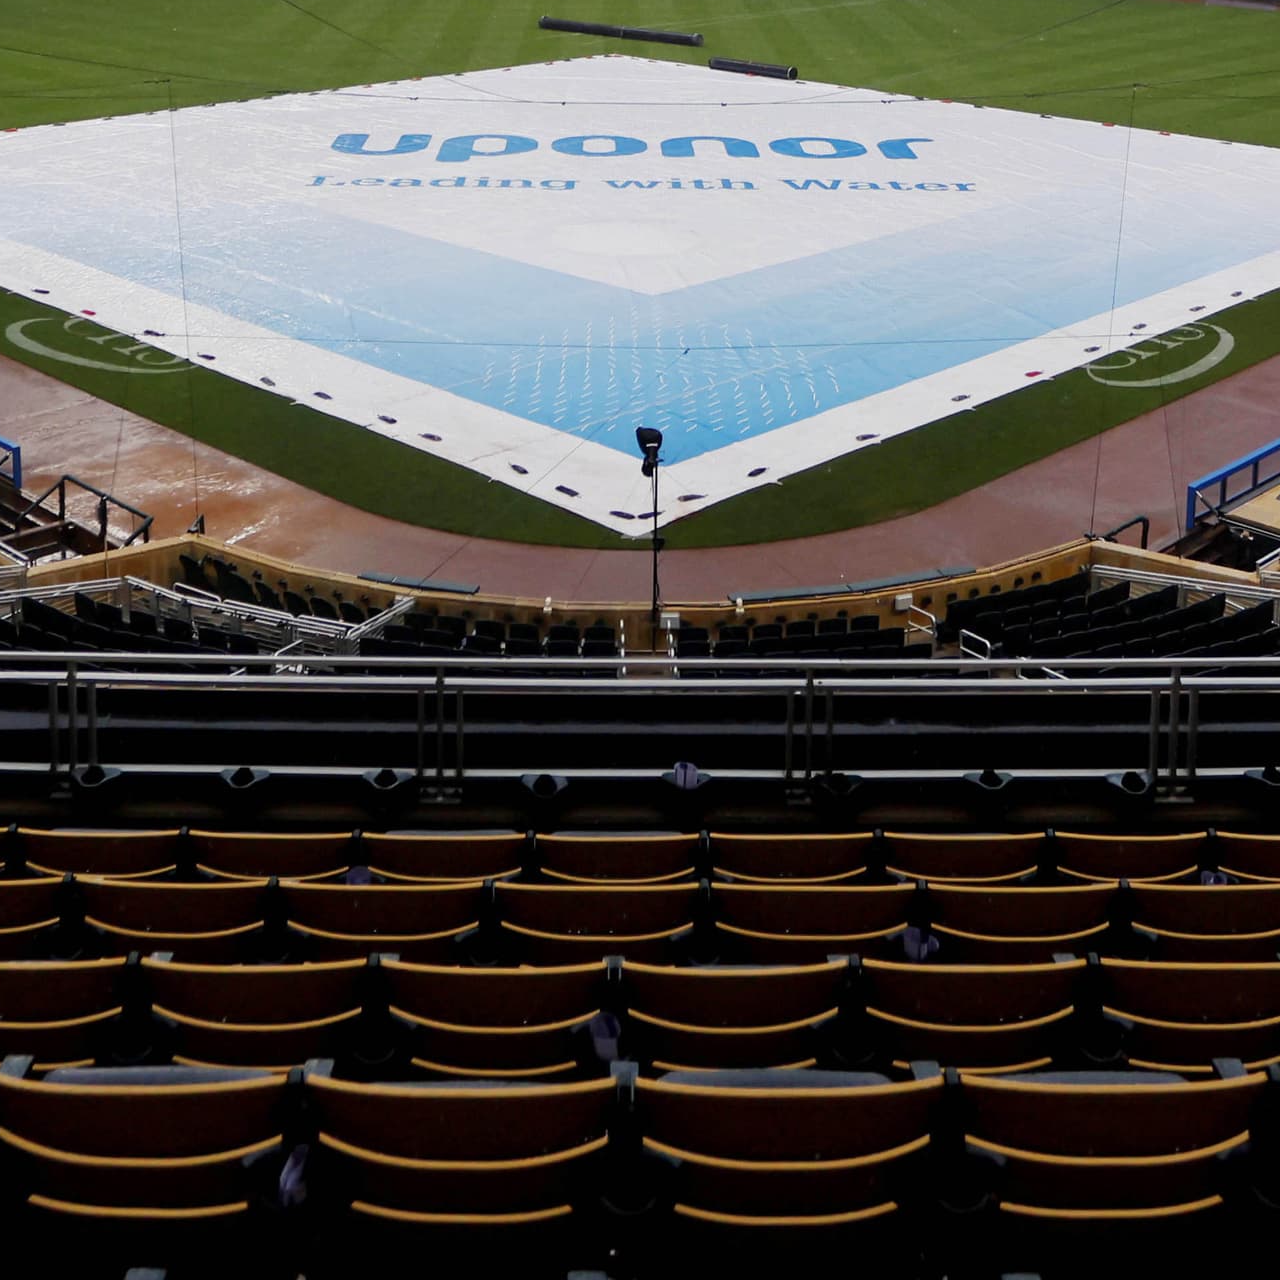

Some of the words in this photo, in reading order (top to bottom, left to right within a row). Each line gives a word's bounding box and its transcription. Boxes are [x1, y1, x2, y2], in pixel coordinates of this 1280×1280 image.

[330, 131, 935, 163] uponor
[306, 176, 581, 192] Leading
[610, 175, 760, 191] with
[781, 176, 978, 193] Water
